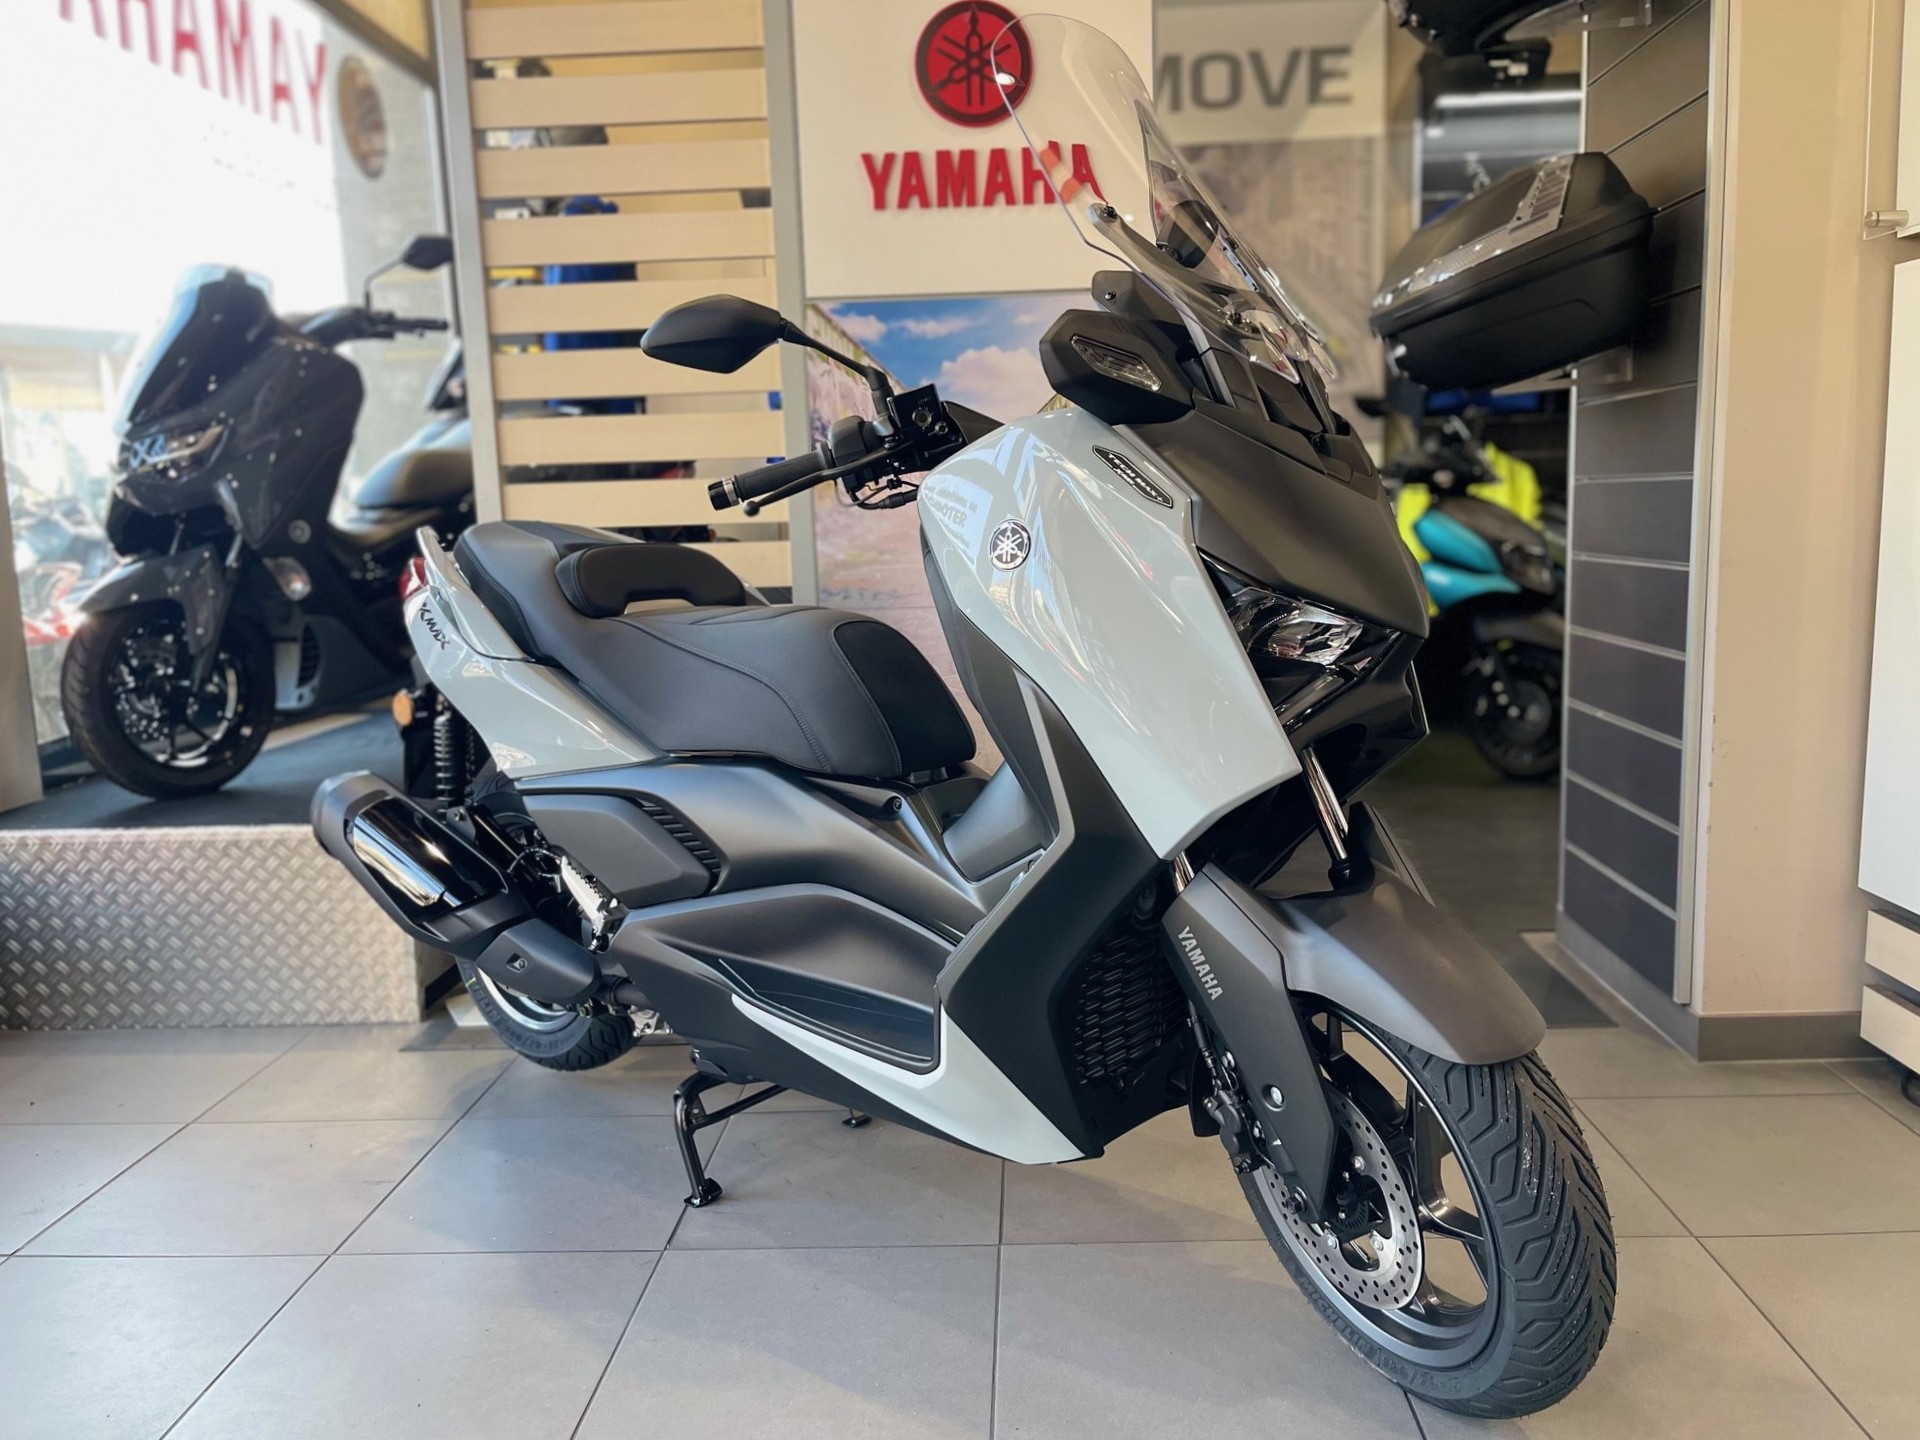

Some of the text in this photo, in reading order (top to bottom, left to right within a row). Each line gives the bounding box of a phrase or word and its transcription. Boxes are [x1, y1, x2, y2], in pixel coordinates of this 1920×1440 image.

[861, 140, 1108, 210] YAMAHA
[420, 602, 451, 650] XMAX
[1178, 925, 1224, 1001] YAMAHA
